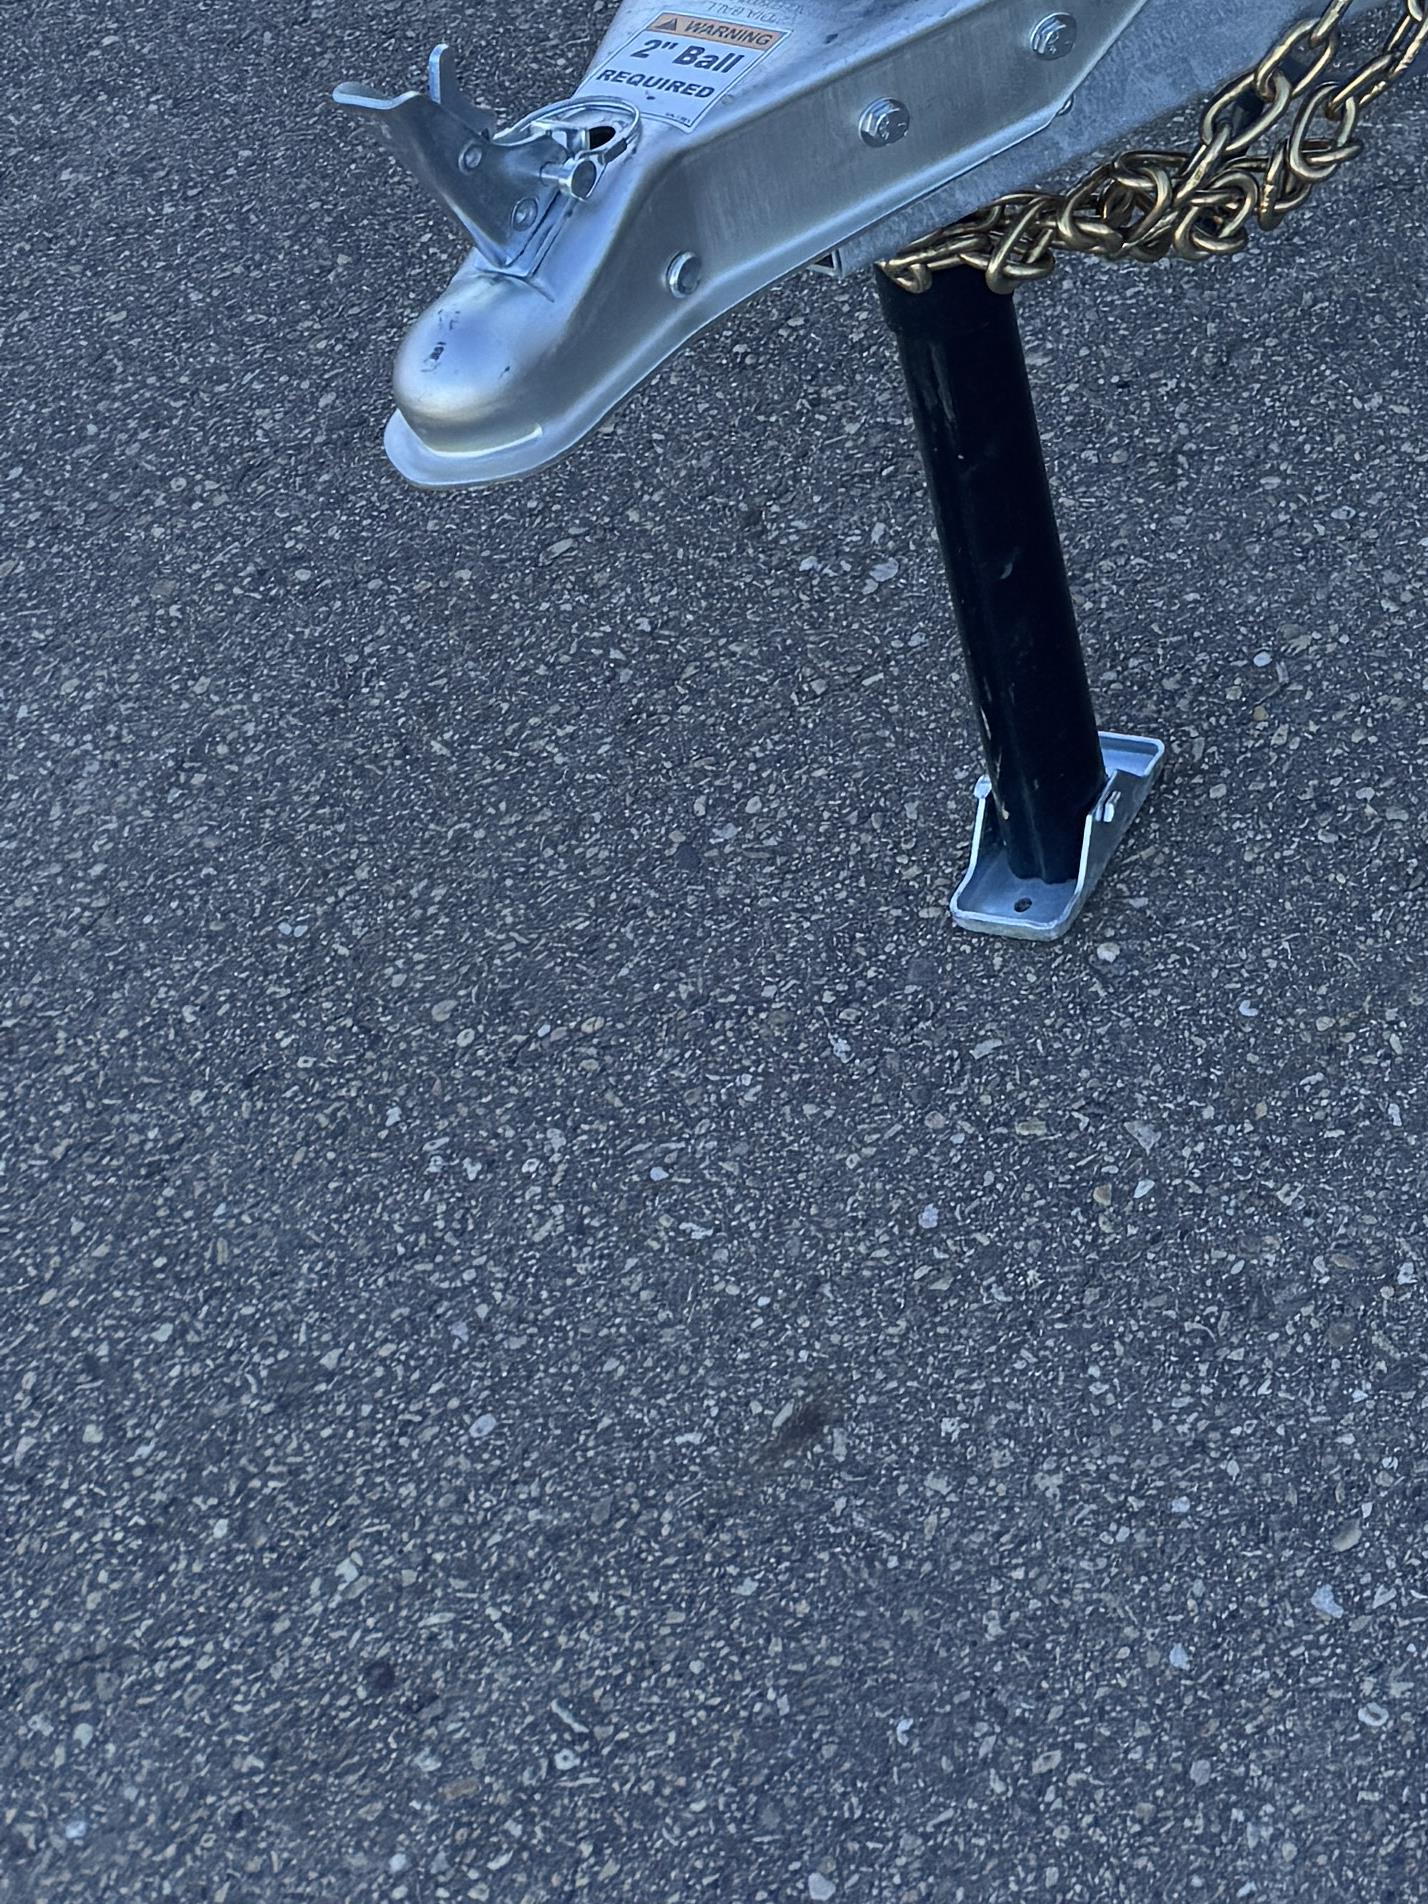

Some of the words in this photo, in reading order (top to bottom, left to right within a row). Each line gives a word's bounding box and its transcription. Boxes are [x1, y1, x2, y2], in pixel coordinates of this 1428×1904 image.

[684, 20, 773, 45] WARNING
[630, 39, 678, 59] 2"
[672, 45, 745, 73] Ball
[596, 69, 715, 98] REQUIRED
